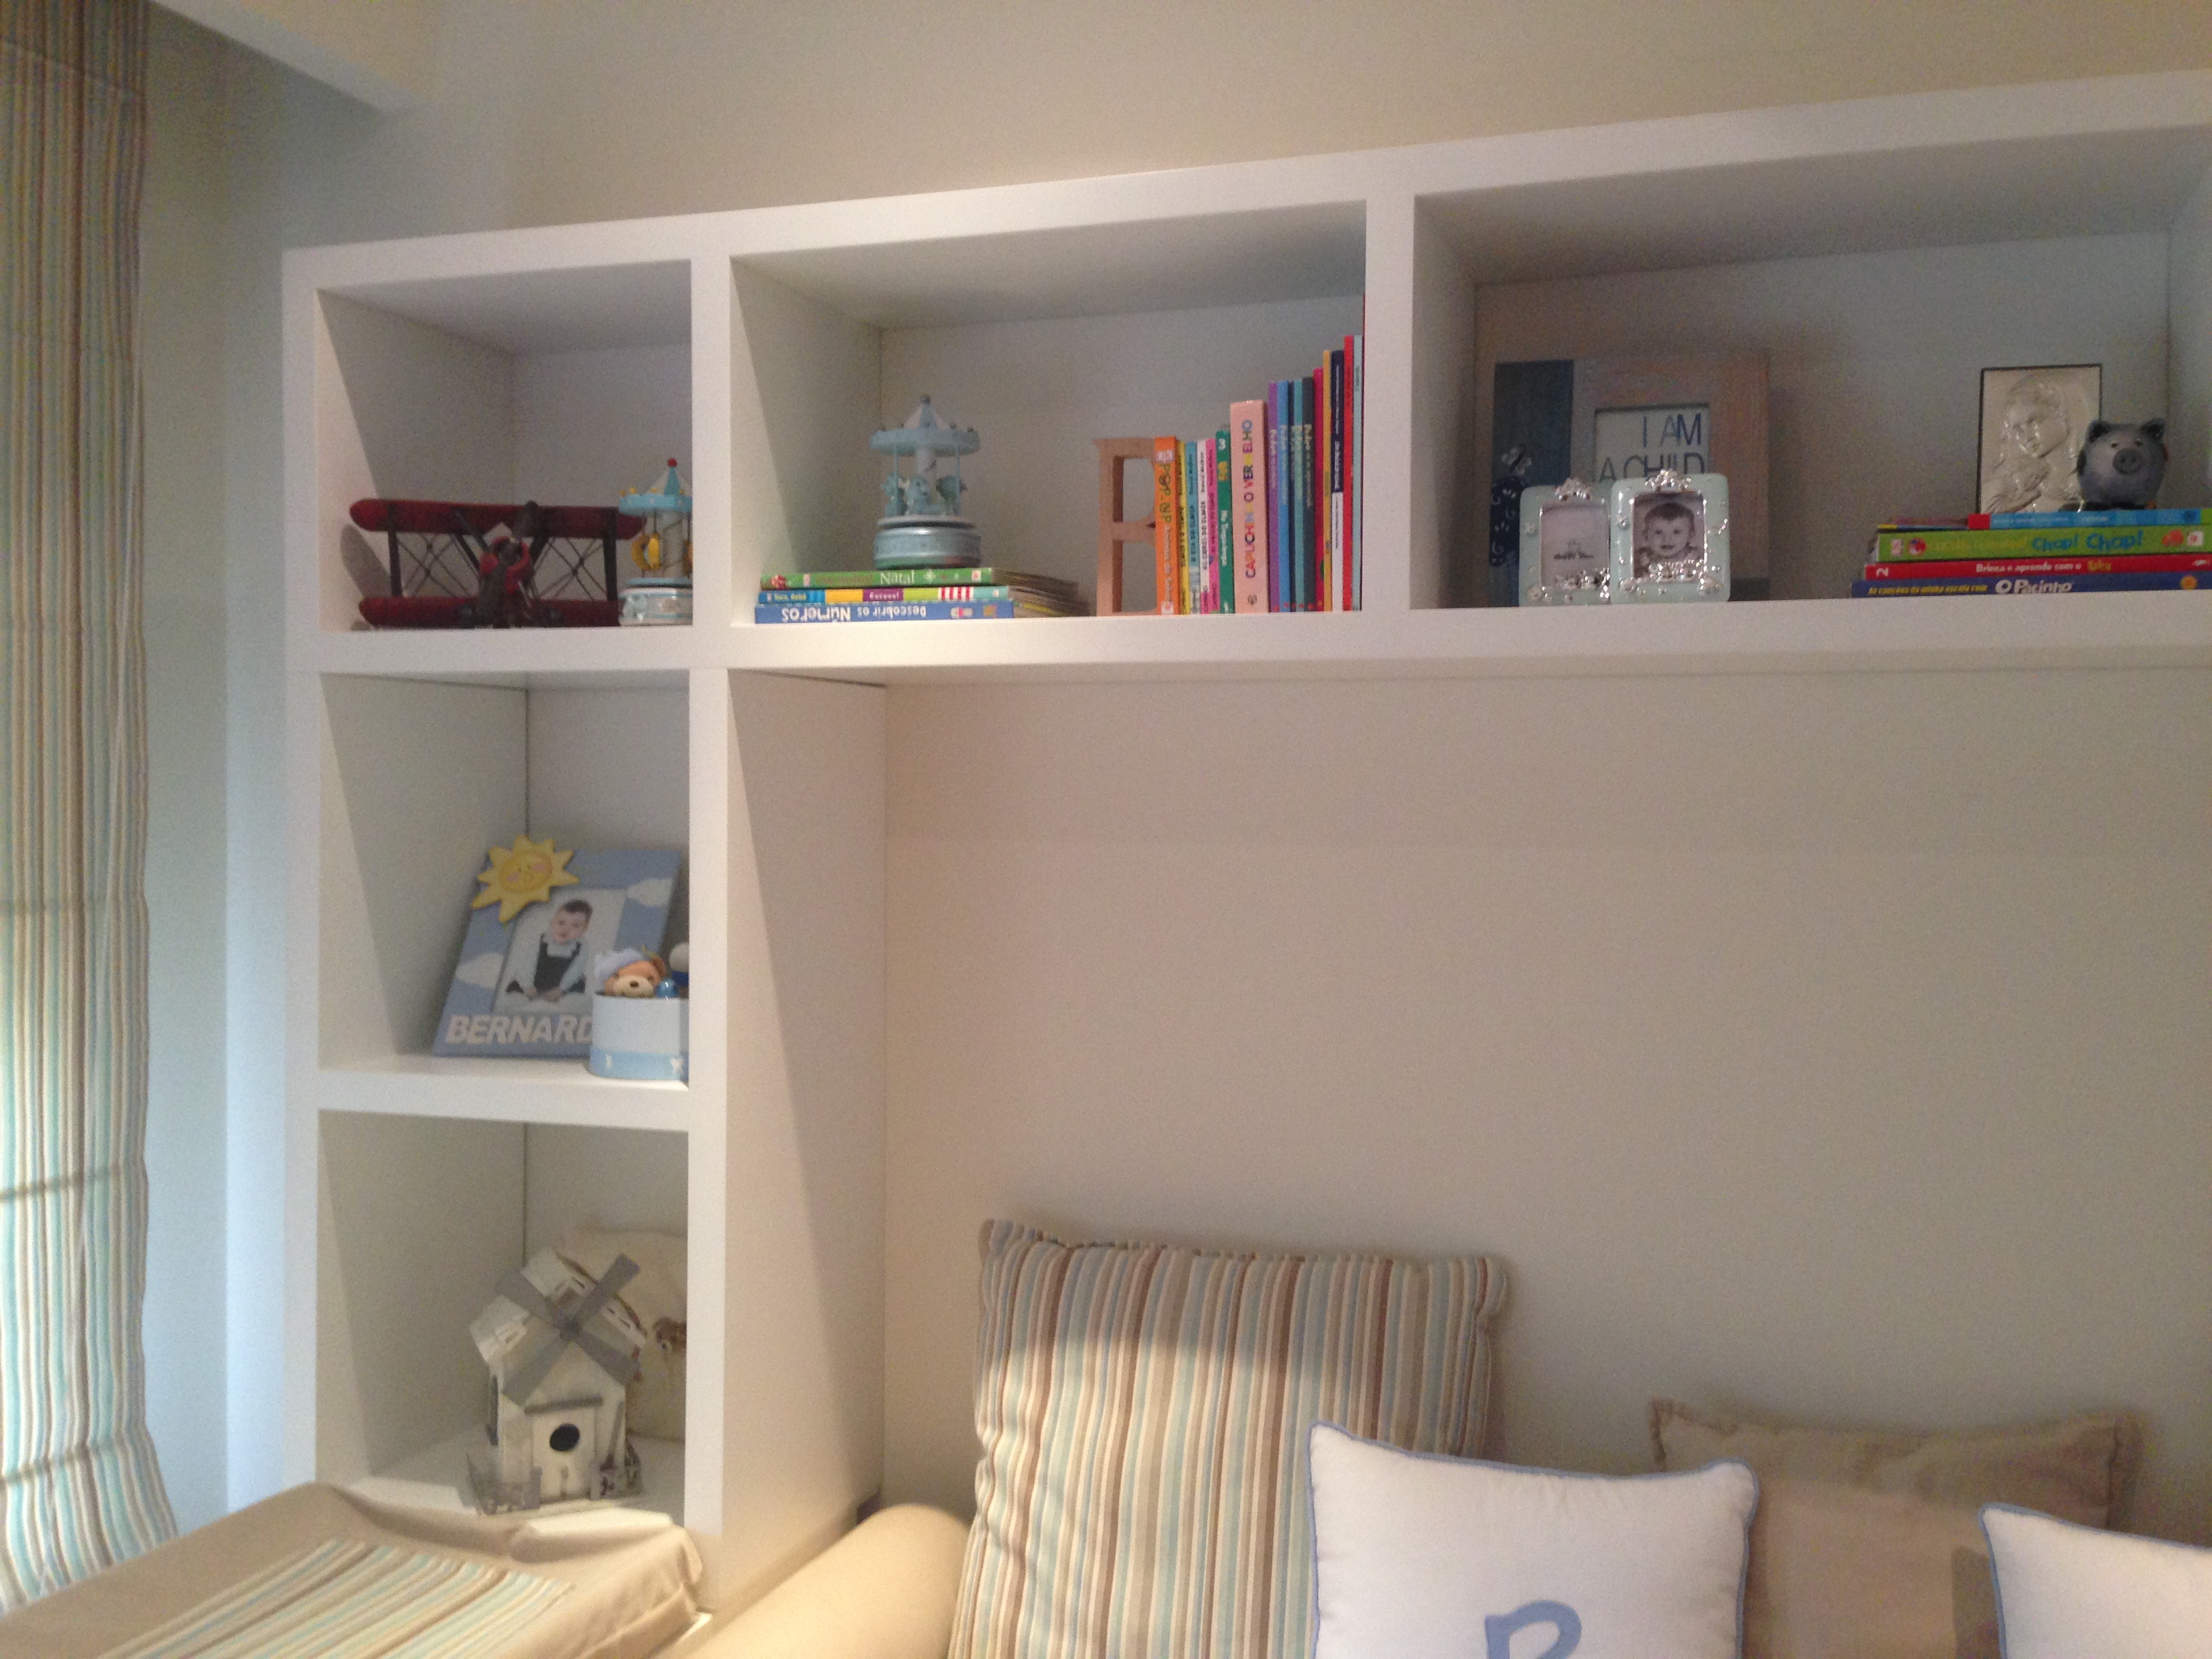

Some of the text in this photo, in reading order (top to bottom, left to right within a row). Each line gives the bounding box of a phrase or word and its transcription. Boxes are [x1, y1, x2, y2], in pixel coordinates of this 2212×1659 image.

[1643, 412, 1702, 447] I AM
[1241, 419, 1254, 489] VERMELHO
[1599, 457, 1616, 483] A
[2086, 530, 2144, 551] Chap!
[880, 569, 915, 585] Natal
[1975, 562, 2005, 573] Brinca
[1994, 579, 2012, 595] O
[781, 605, 926, 624] Descobrir os Números
